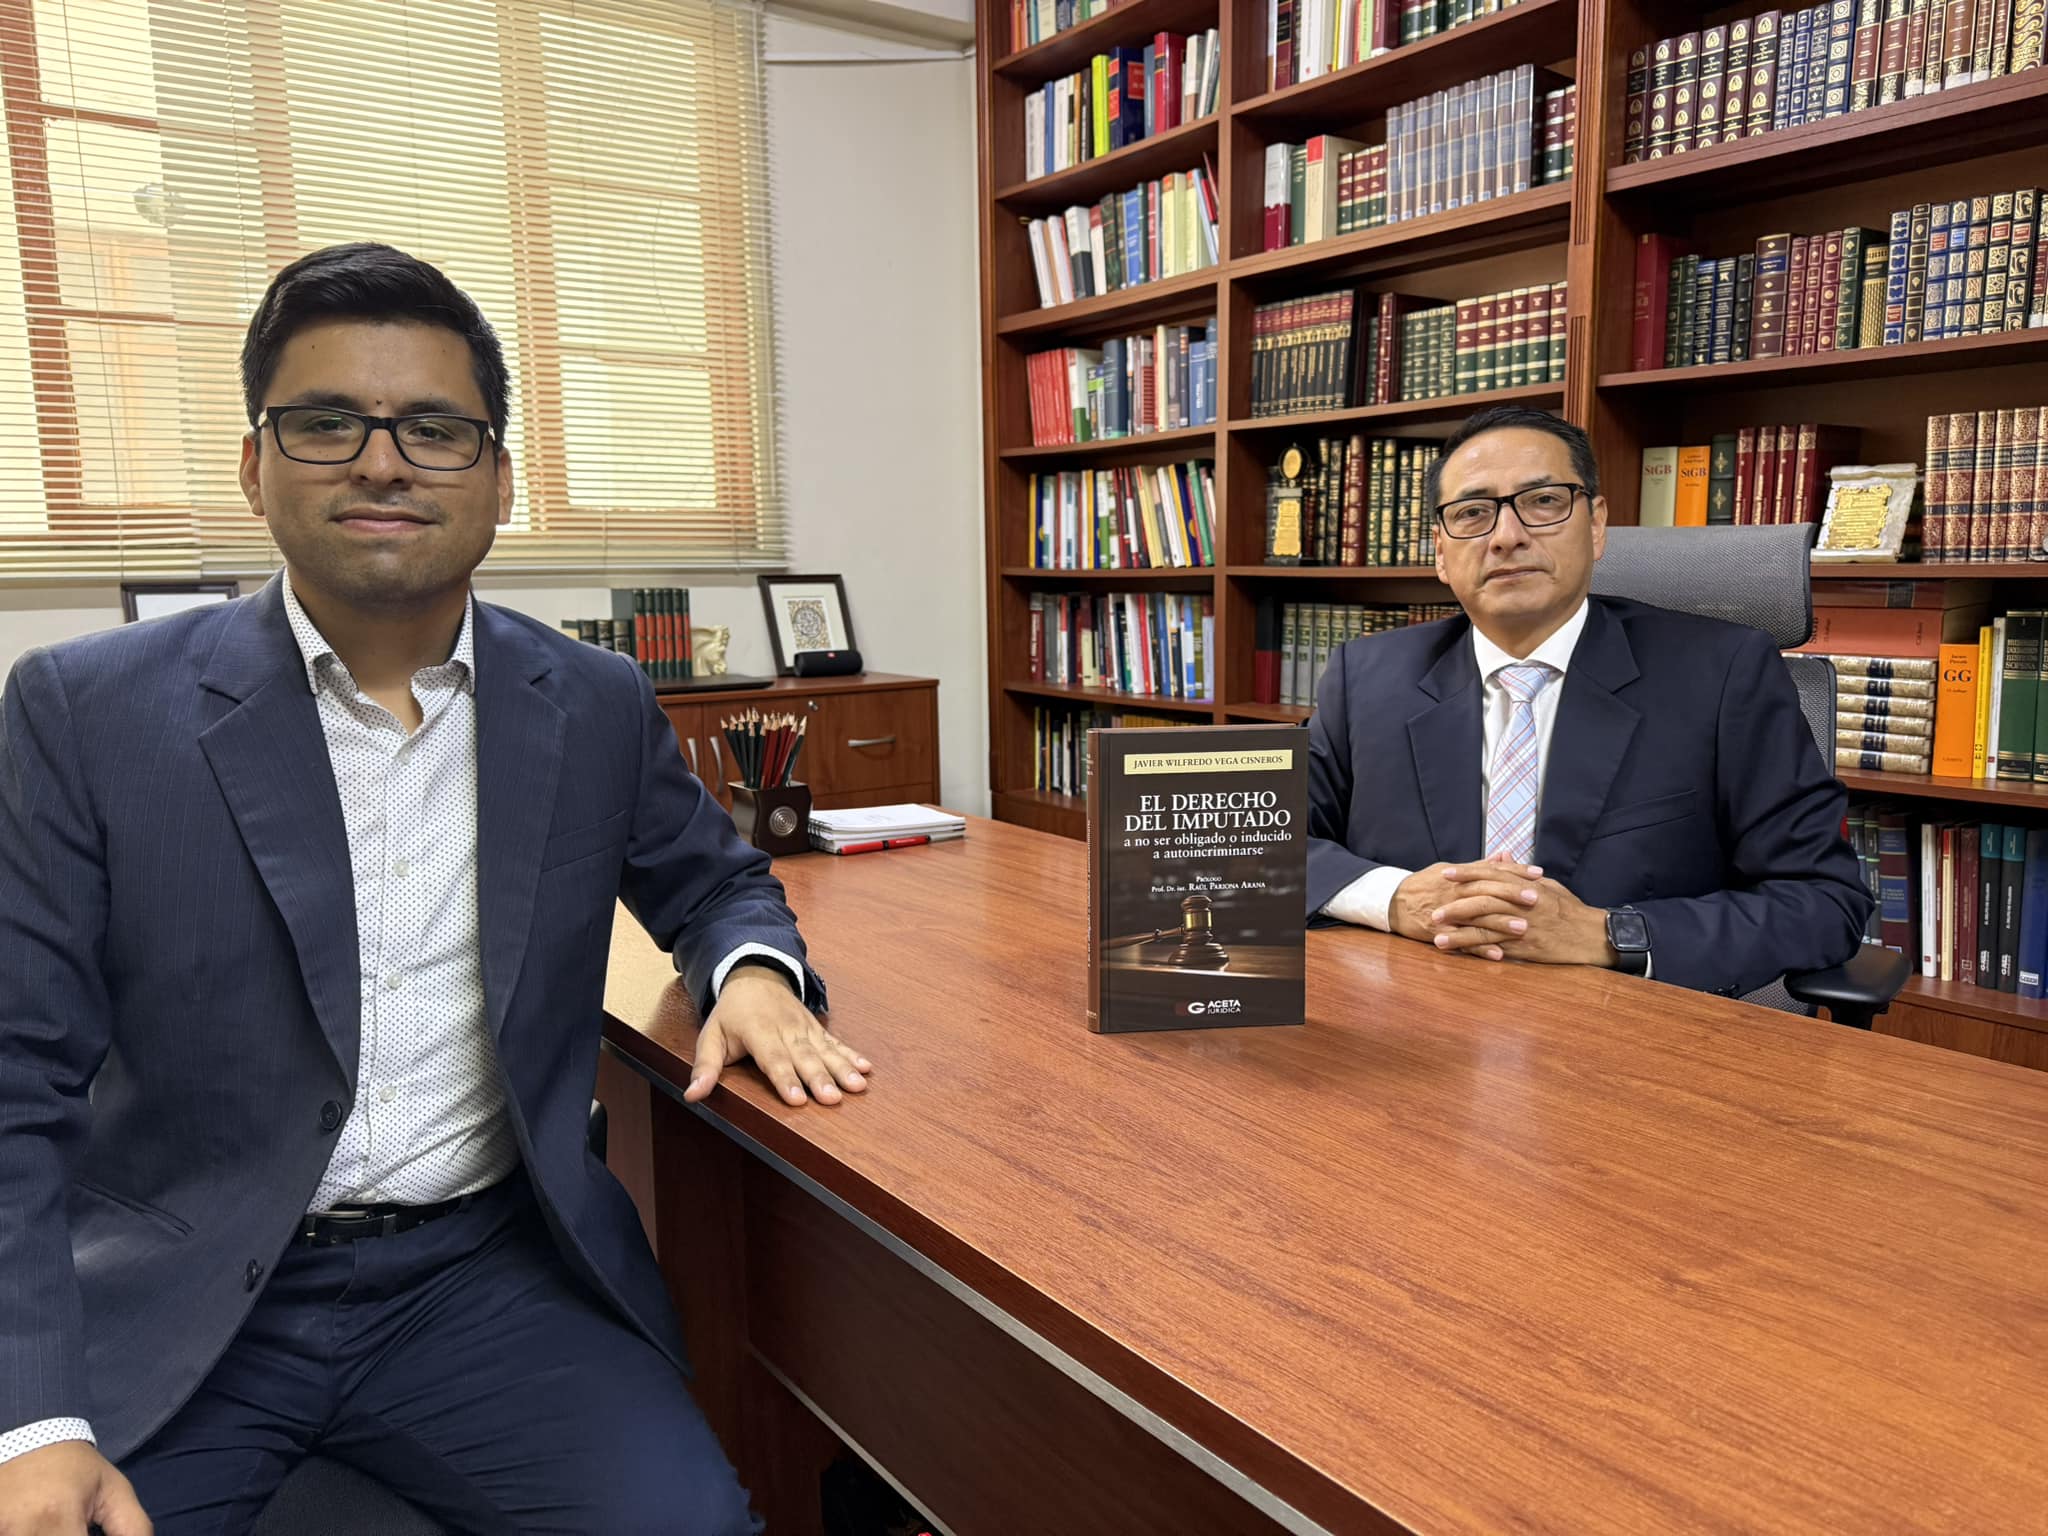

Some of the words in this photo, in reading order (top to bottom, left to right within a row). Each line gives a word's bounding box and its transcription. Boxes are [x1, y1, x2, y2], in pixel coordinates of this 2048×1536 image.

[1644, 464, 1672, 476] StGB
[1680, 467, 1707, 478] StGB
[1943, 668, 1972, 682] GG
[1134, 759, 1164, 770] JAVIER
[1165, 757, 1213, 768] WILFREDO
[1214, 756, 1239, 766] VEGA
[1240, 755, 1283, 765] CISNEROS
[1139, 795, 1166, 813] EL
[1171, 791, 1277, 811] DERECHO
[1125, 814, 1167, 832] DEL
[1172, 810, 1291, 830] IMPUTADO
[1123, 839, 1131, 847] a
[1135, 838, 1150, 847] no
[1154, 836, 1171, 846] ser
[1174, 831, 1226, 847] obligado
[1229, 834, 1238, 843] o
[1241, 829, 1292, 843] inducido
[1153, 851, 1160, 859] a
[1163, 845, 1264, 859] autoincriminarse
[1151, 885, 1165, 893] Prof.
[1209, 881, 1239, 891] PARIONA
[1240, 880, 1266, 889] ARANA
